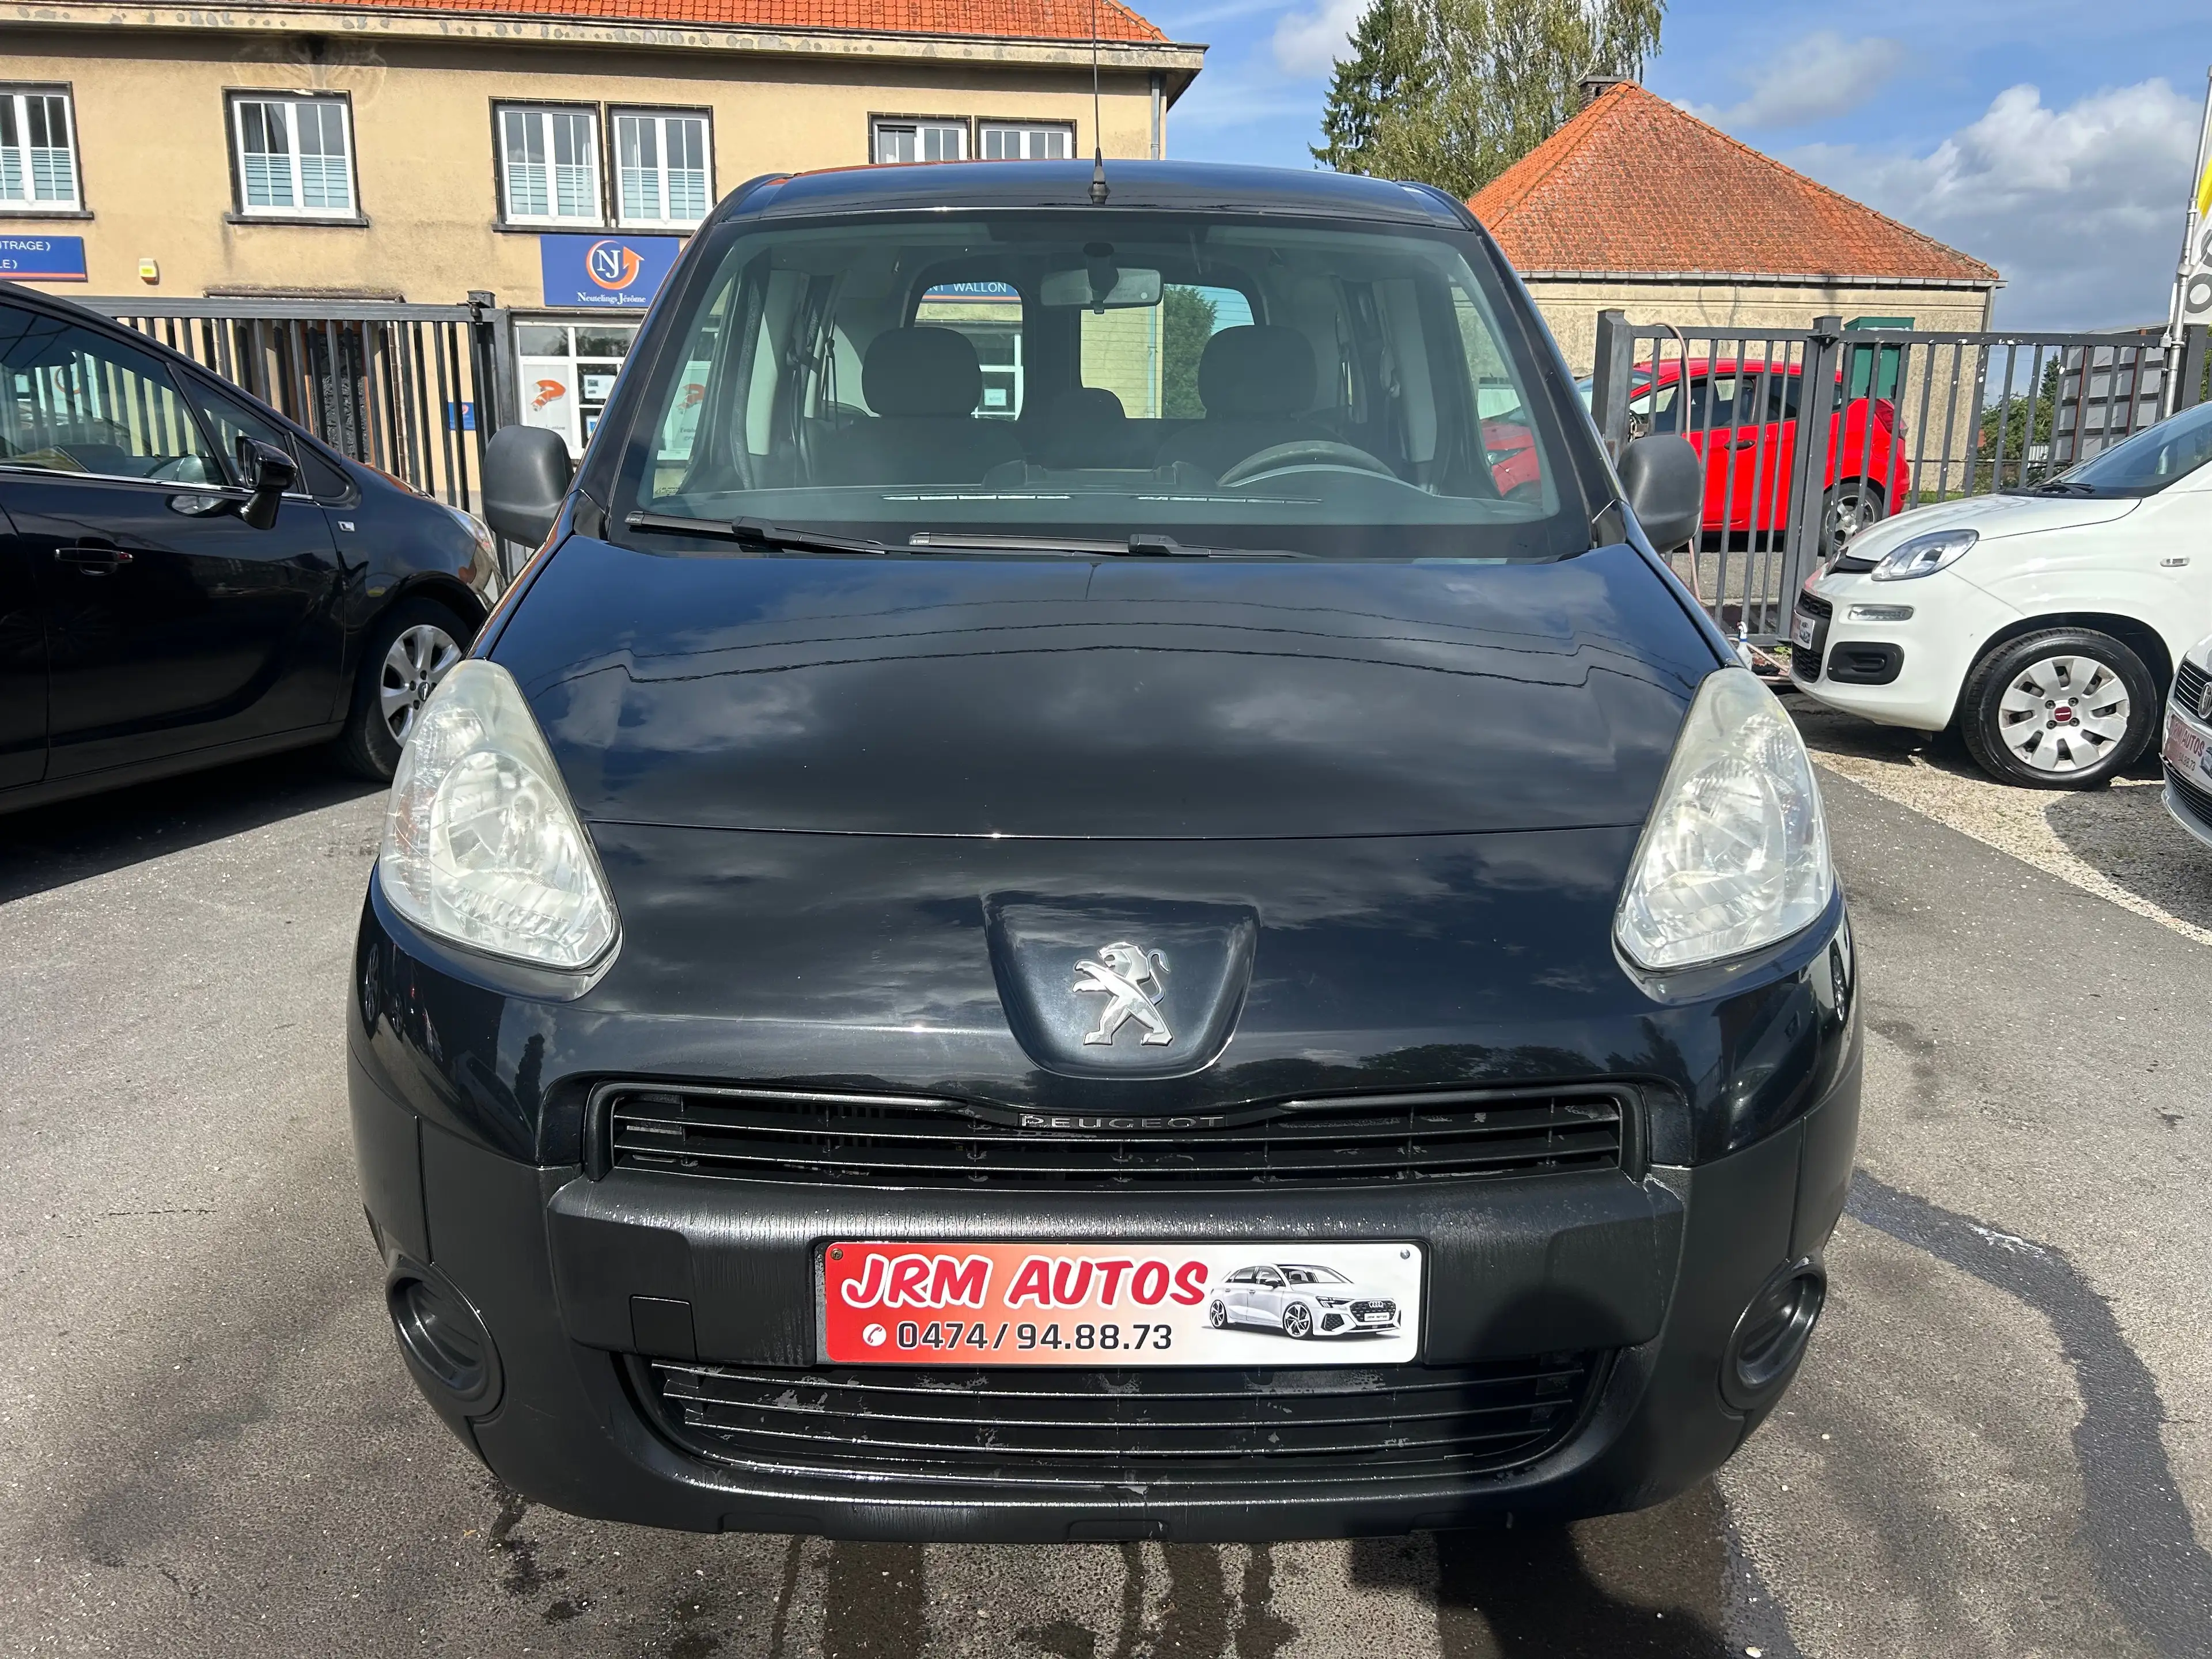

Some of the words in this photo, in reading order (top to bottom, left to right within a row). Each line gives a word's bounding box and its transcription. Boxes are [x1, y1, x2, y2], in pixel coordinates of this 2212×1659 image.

[953, 282, 1007, 293] WALLON
[2181, 728, 2205, 757] AUTOS
[1021, 1113, 1224, 1128] PEUGEOT
[843, 1253, 993, 1309] JRM
[1005, 1256, 1210, 1308] AUTOS
